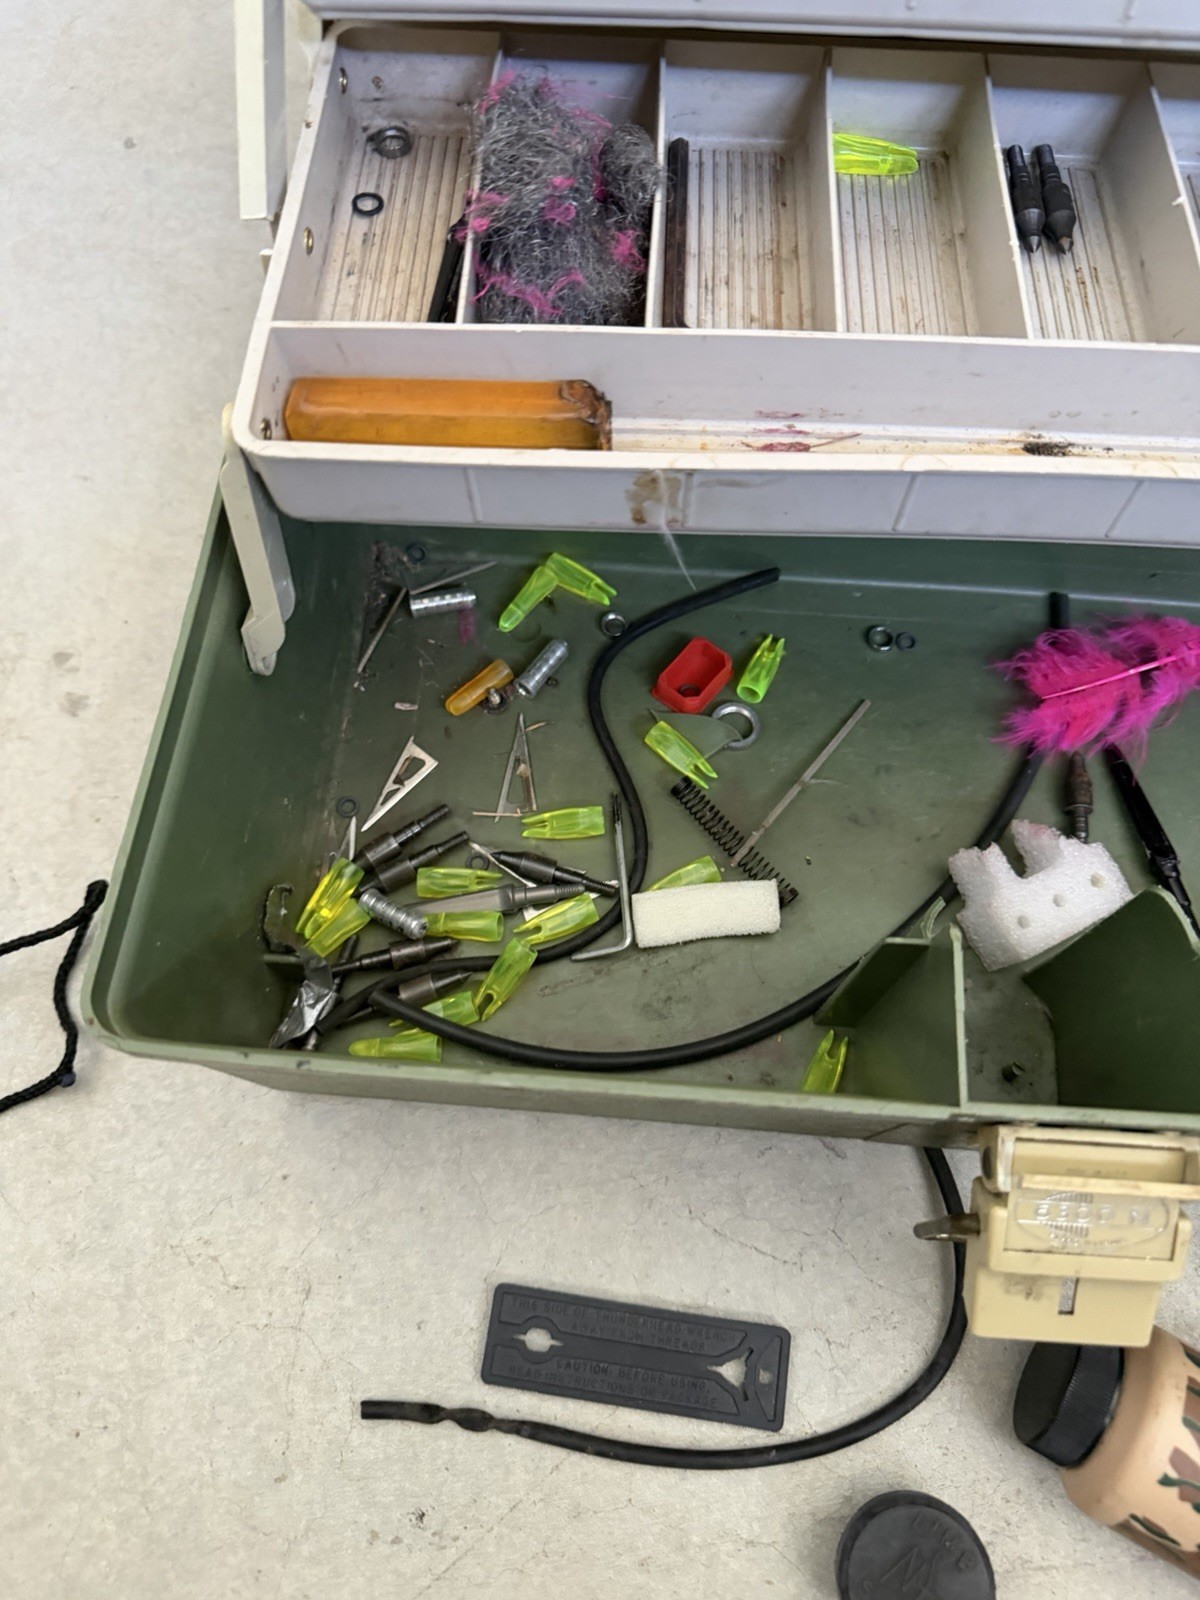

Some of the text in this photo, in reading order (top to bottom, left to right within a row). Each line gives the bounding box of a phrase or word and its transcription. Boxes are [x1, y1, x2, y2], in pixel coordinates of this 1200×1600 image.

[512, 1298, 537, 1311] THIS
[543, 1302, 568, 1315] SIDE
[618, 1369, 666, 1385] BEFORE
[509, 1366, 541, 1379] READ
[545, 1372, 634, 1394] INSTRUCTIONS
[661, 1390, 717, 1409] PACKAGE
